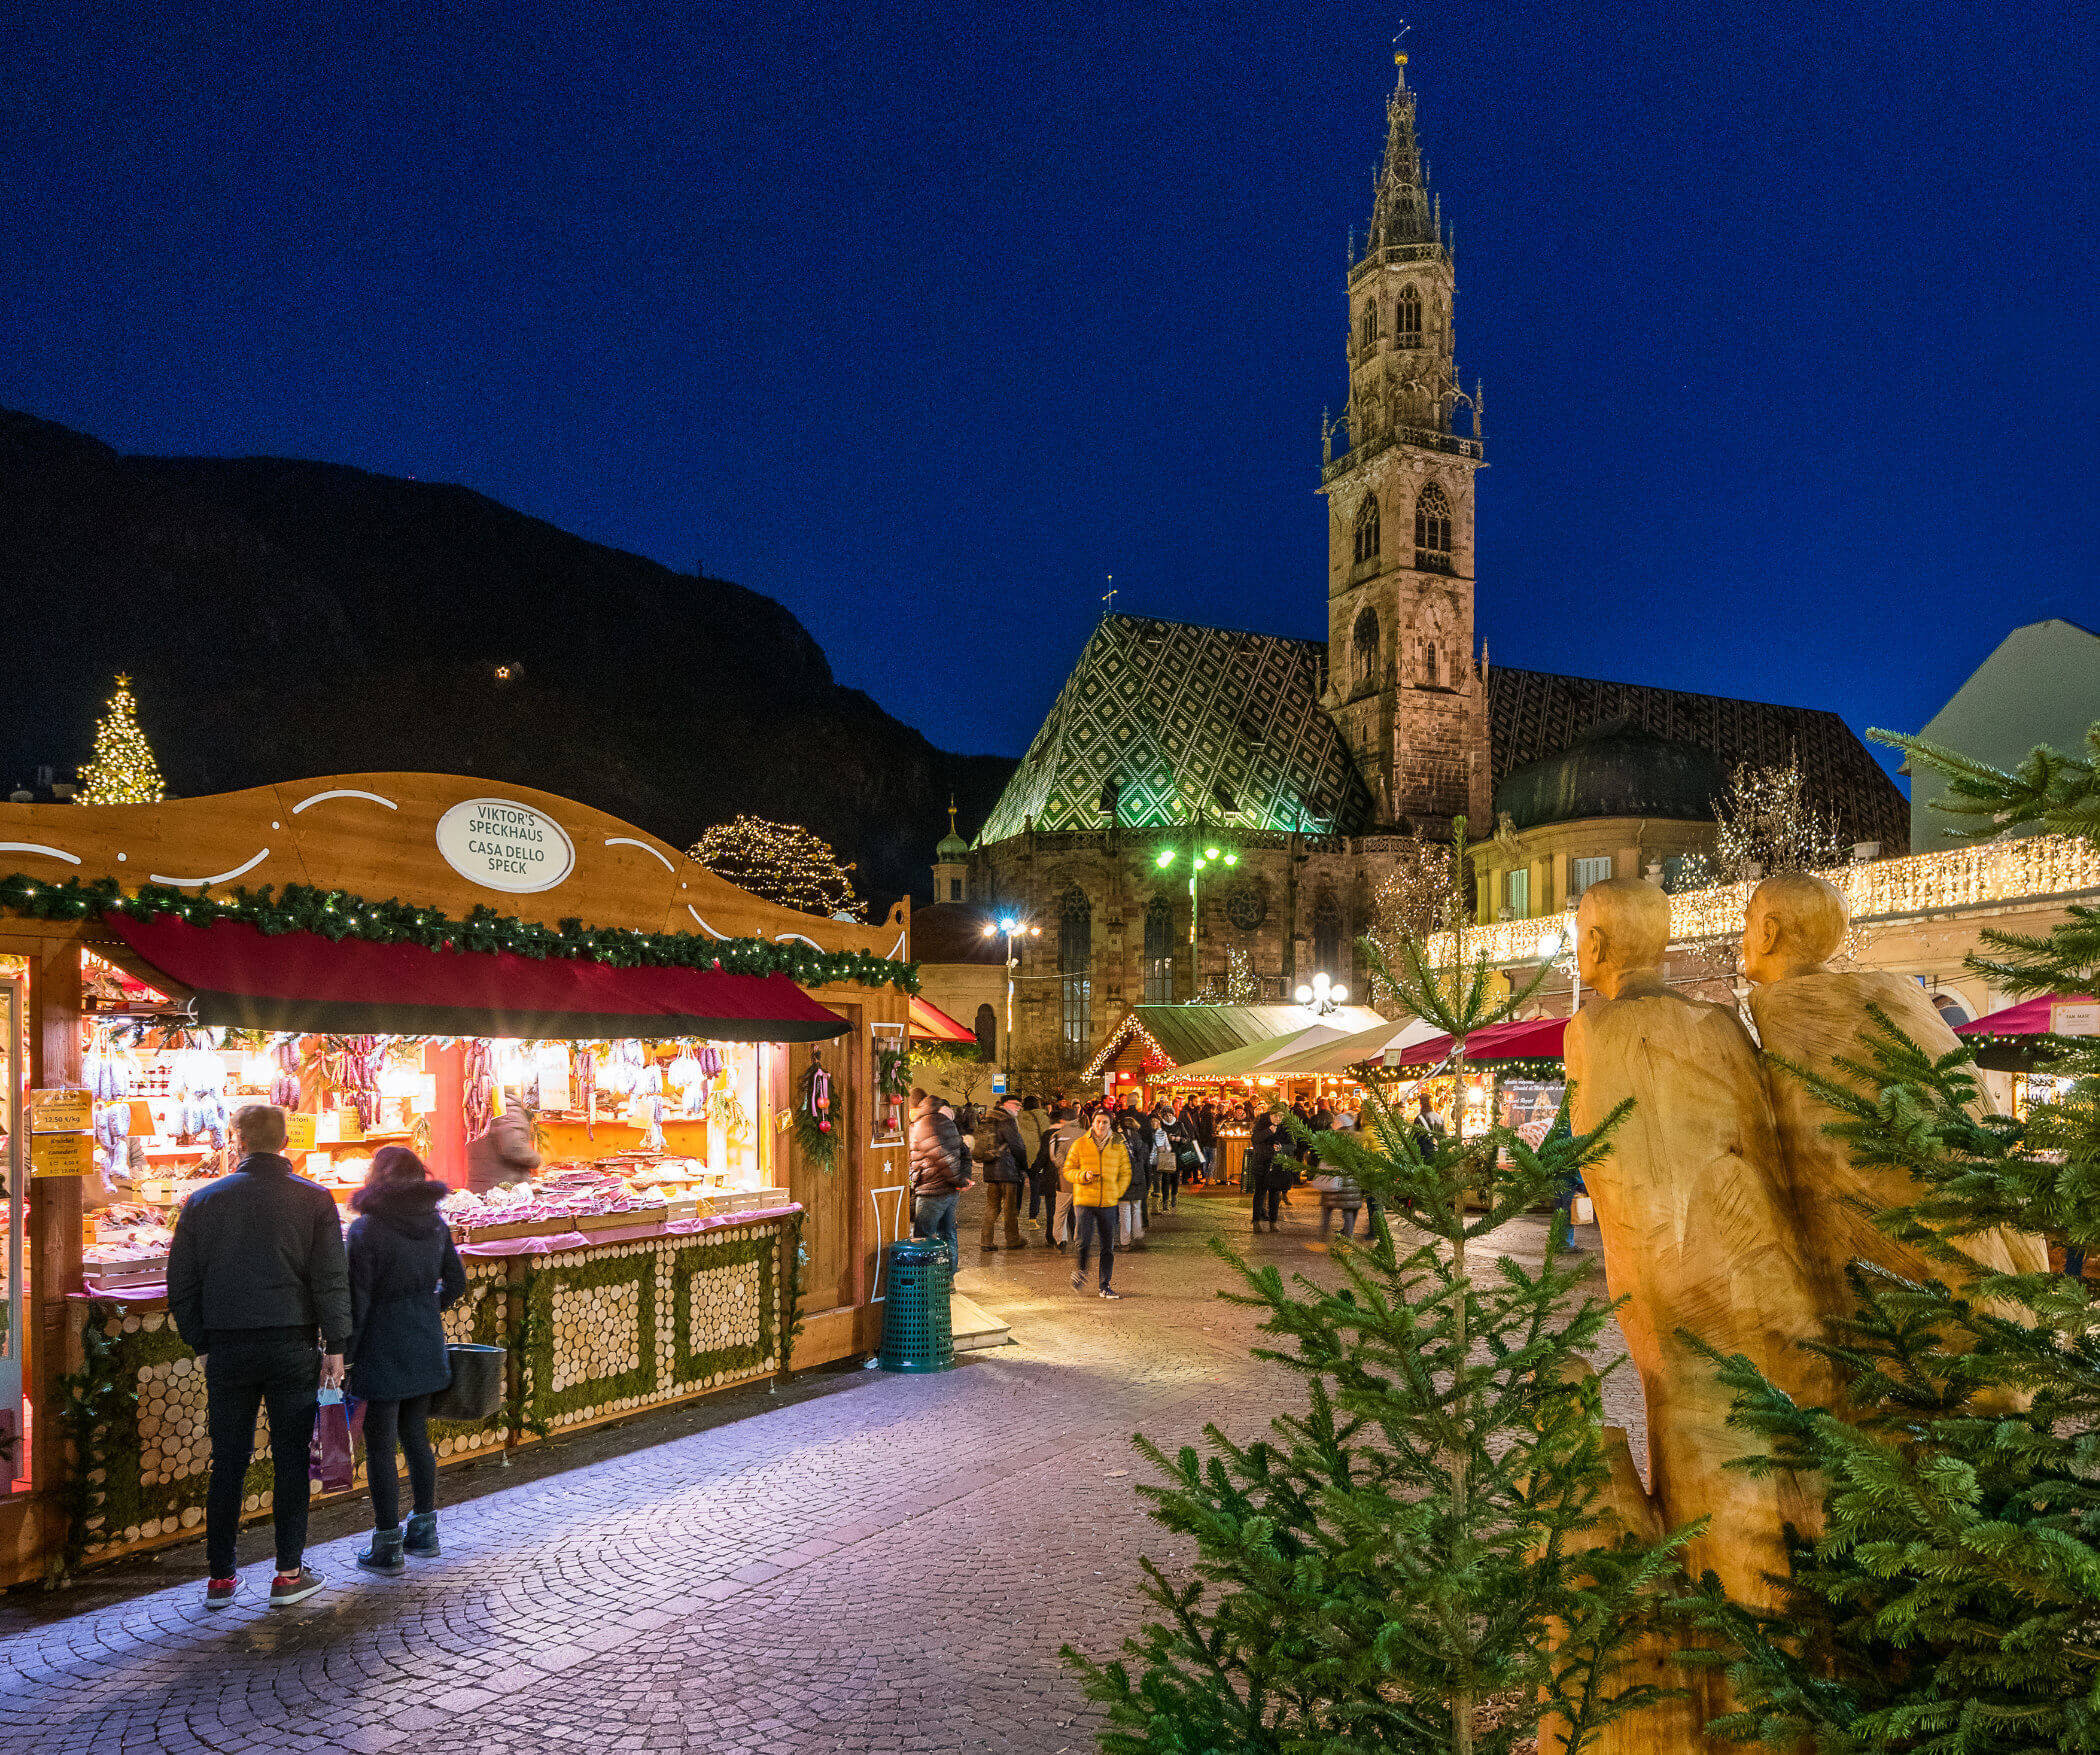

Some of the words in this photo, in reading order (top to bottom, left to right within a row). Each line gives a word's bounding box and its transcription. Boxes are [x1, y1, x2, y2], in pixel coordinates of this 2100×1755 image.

[478, 805, 535, 827] VIKTOR'S
[469, 819, 543, 843] SPECKHAUS
[468, 840, 503, 857] CASA
[505, 845, 545, 862] DELLO
[488, 857, 527, 875] SPECK
